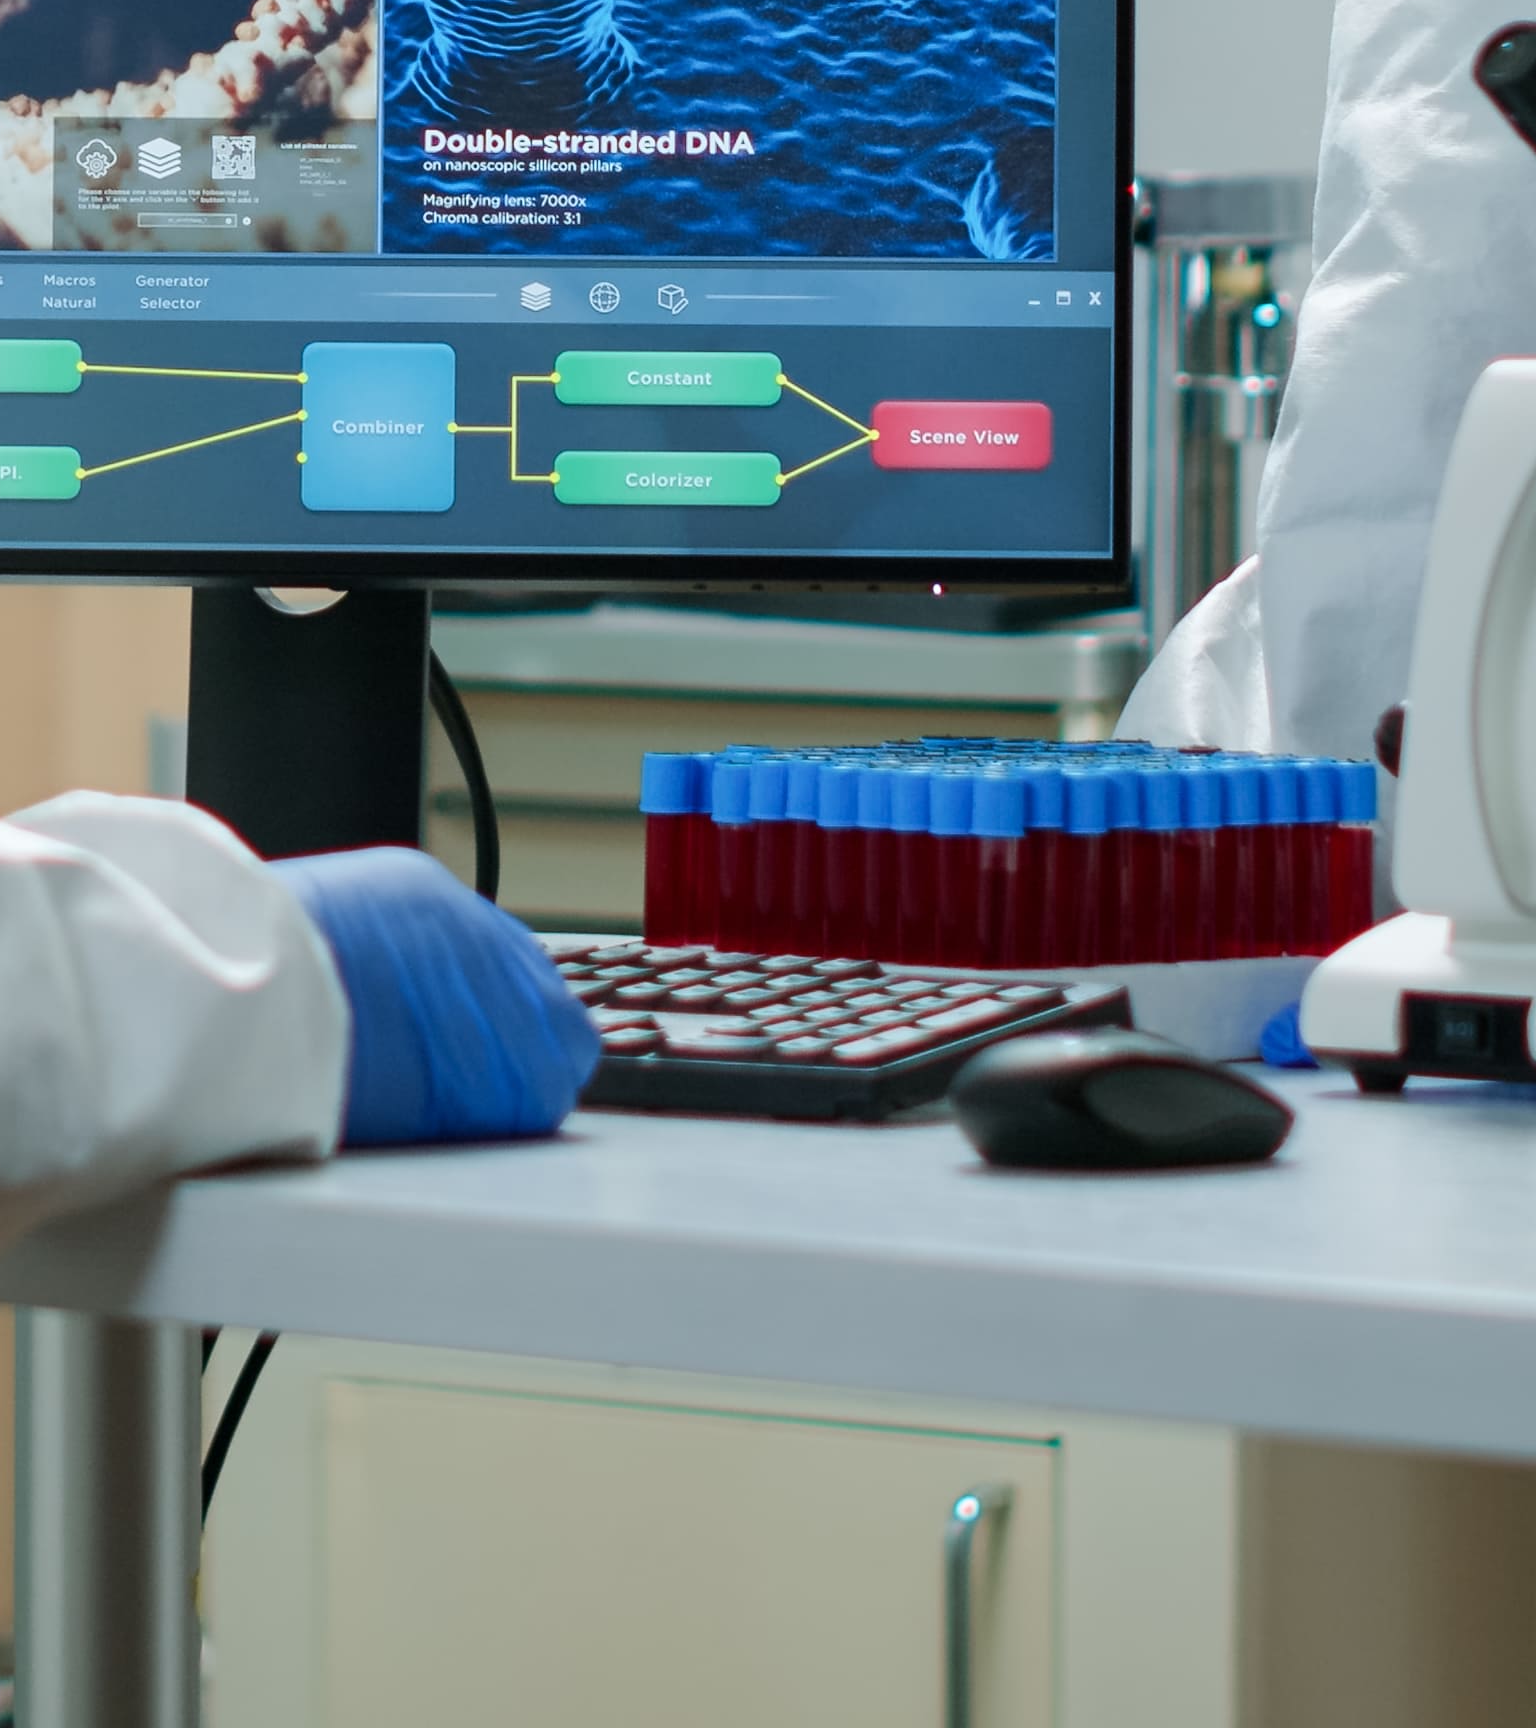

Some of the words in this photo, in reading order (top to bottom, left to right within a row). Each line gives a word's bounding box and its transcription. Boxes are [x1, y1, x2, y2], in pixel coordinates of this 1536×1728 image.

[424, 128, 676, 154] Double-stranded
[686, 131, 755, 155] DNA
[423, 161, 442, 171] on
[445, 159, 525, 174] nanoscopic
[529, 159, 577, 172] sillicon
[580, 159, 622, 174] pillars
[423, 193, 501, 209] Magnifying
[504, 194, 536, 207] lens:
[540, 194, 586, 207] 7000x
[422, 211, 479, 224] Chroma
[481, 211, 560, 225] calibration:
[563, 211, 581, 225] 3:1
[43, 274, 97, 287] Macros
[135, 274, 210, 288] Generator
[42, 296, 97, 309] Natural
[140, 297, 201, 310] Selector
[627, 370, 712, 386] Constant
[332, 419, 425, 435] Combiner
[910, 429, 967, 445] Scene
[973, 430, 1019, 445] View
[625, 472, 713, 488] Colorizer
